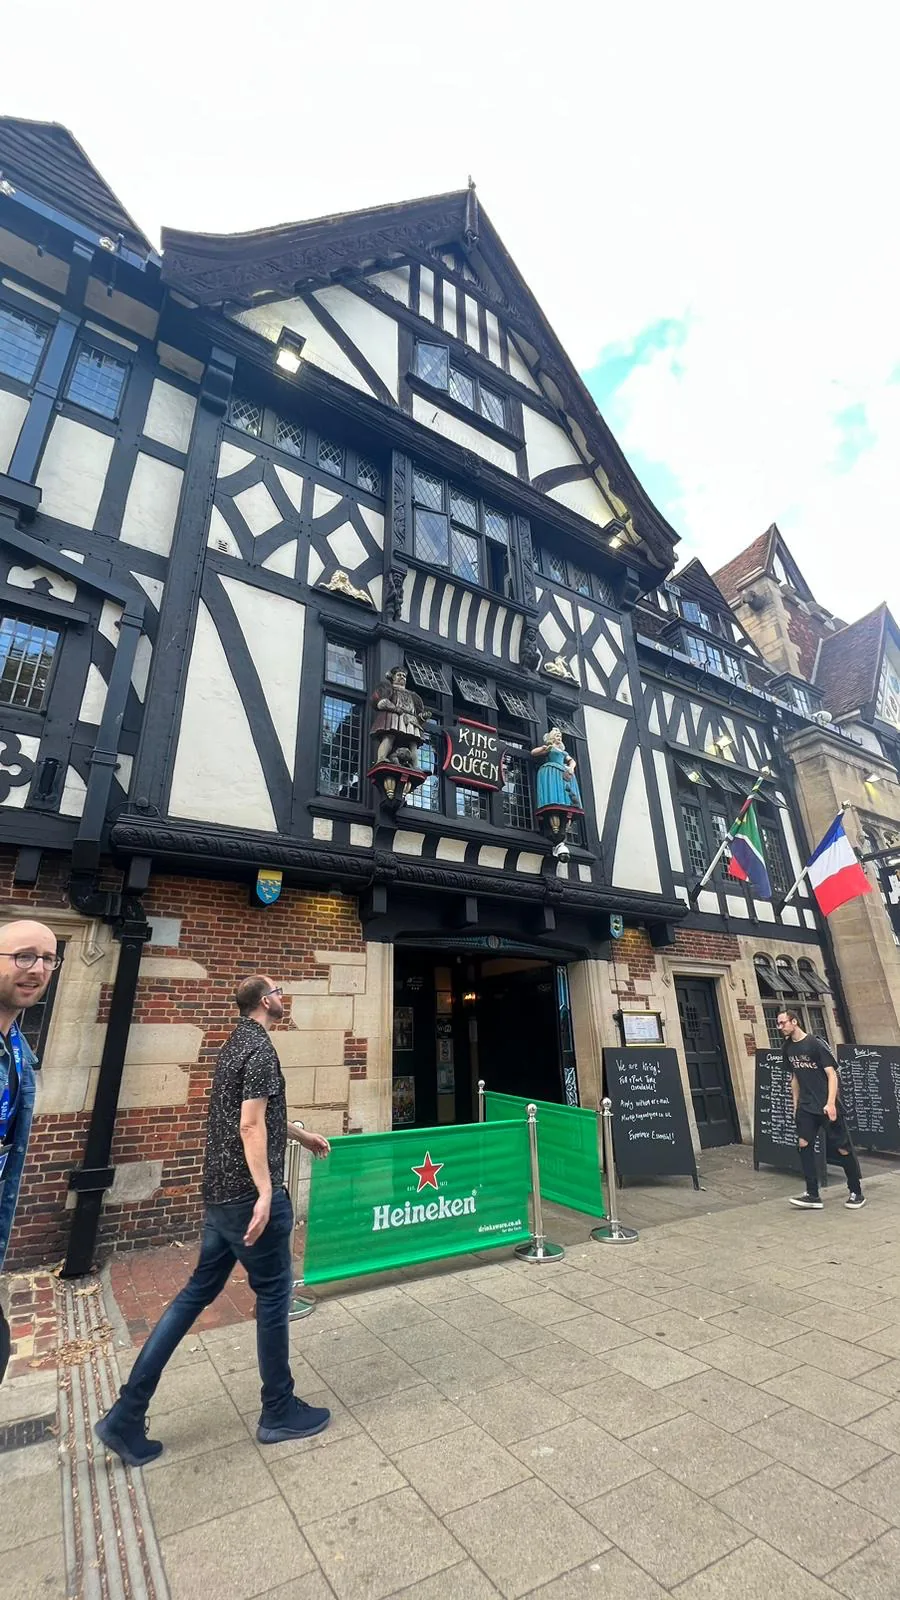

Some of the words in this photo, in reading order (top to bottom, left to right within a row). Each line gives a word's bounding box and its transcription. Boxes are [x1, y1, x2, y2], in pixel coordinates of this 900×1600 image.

[458, 728, 498, 751] KING
[467, 747, 488, 759] AND
[450, 753, 499, 781] QUEEN
[615, 1059, 626, 1071] We
[792, 1061, 818, 1069] STONES
[372, 1196, 477, 1231] Heineken
